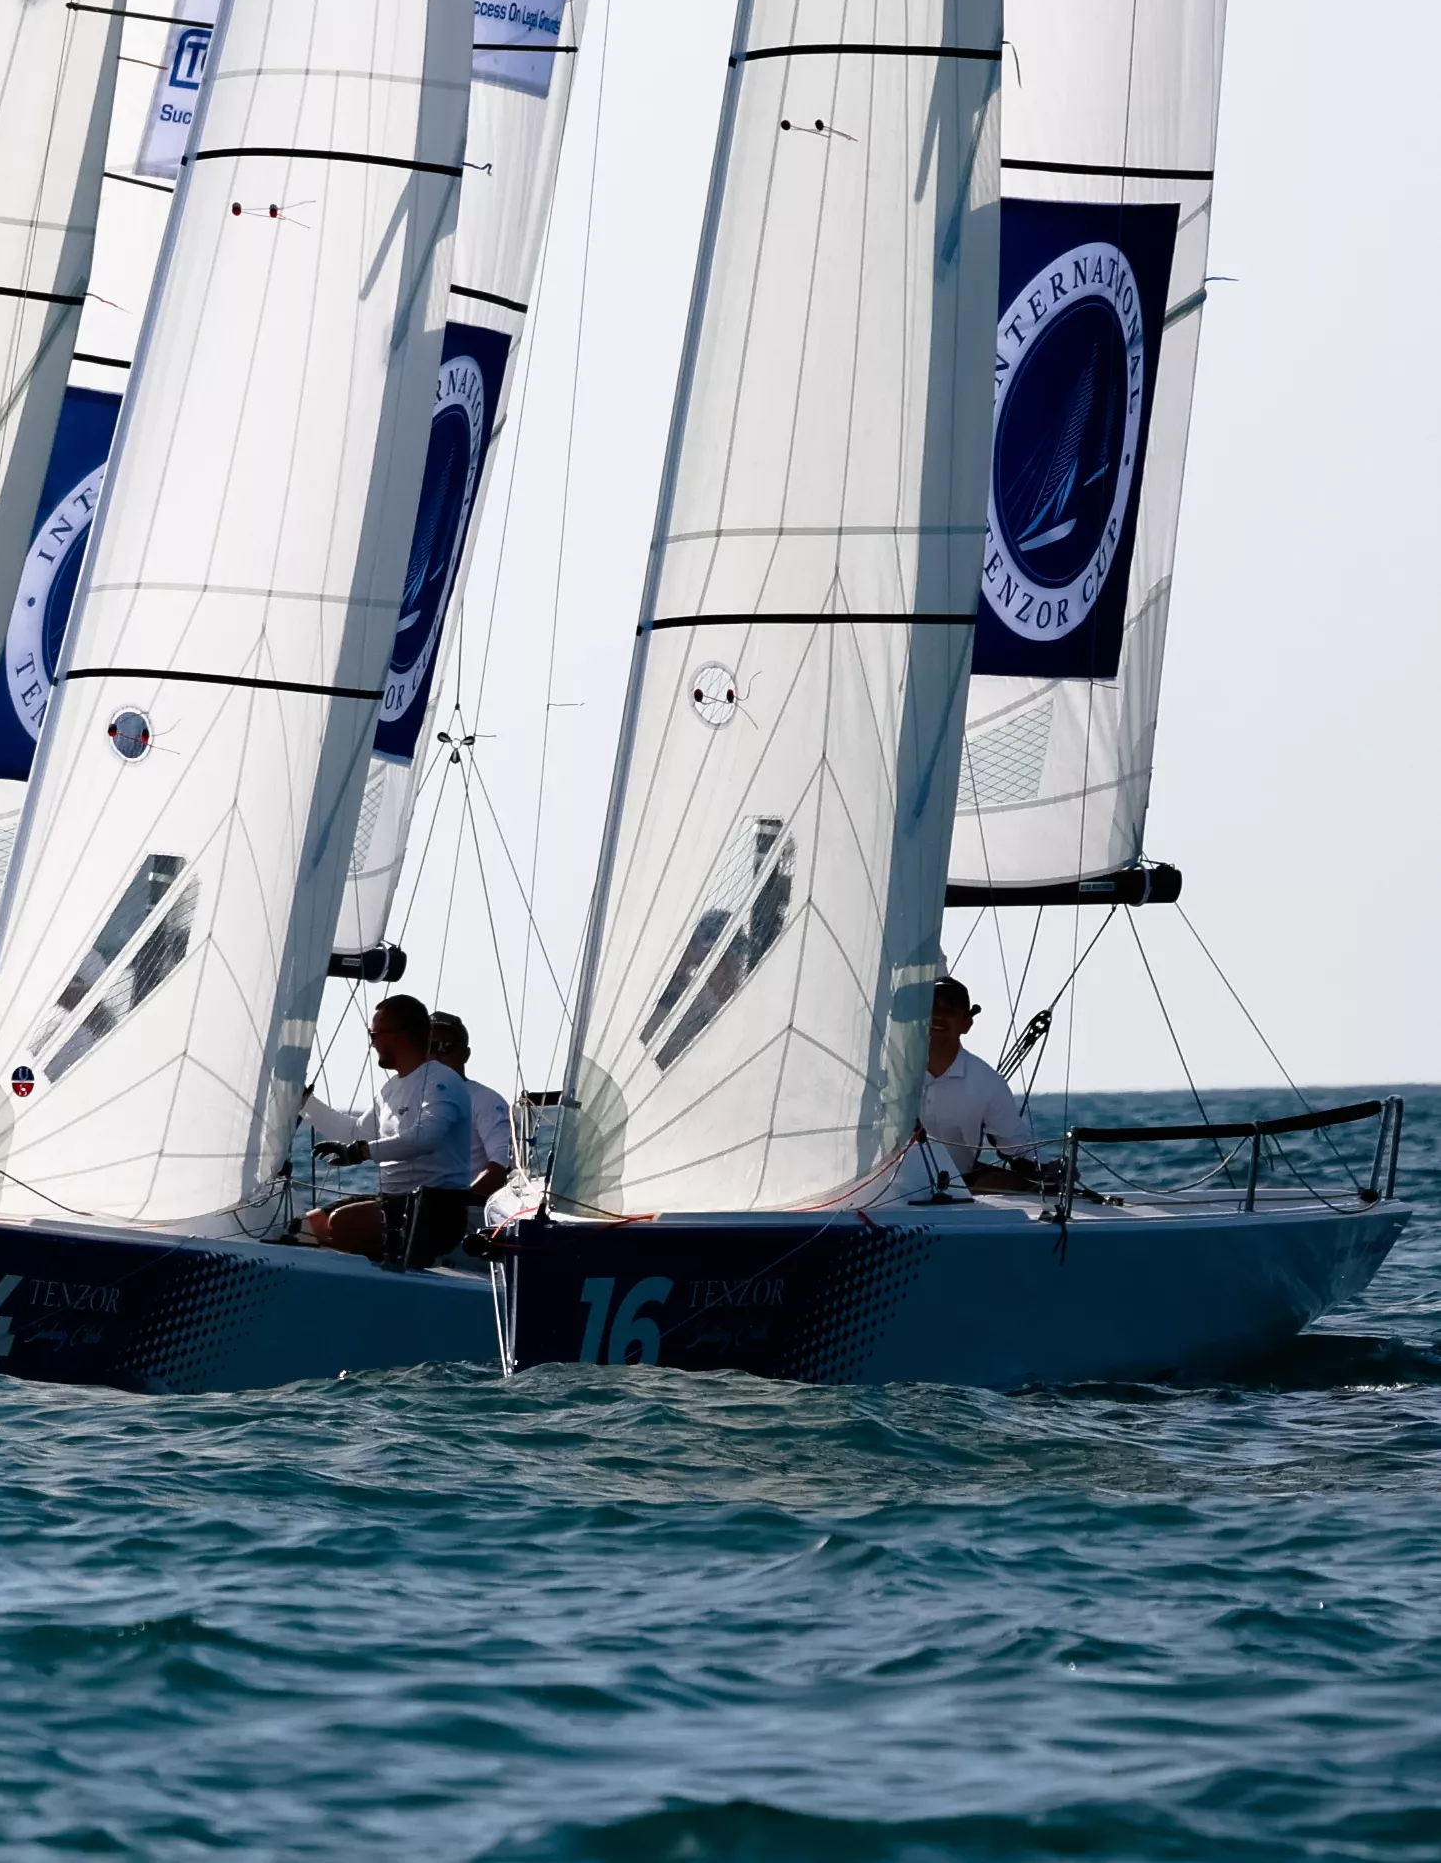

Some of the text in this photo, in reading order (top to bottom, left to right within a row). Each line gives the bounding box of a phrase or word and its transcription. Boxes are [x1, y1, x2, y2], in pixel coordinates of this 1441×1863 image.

[474, 0, 507, 19] ccess
[509, 3, 521, 22] On
[994, 252, 1140, 414] NTERNATIONAL
[1082, 517, 1119, 604] CUP
[30, 1279, 121, 1314] TENZOR
[579, 1276, 786, 1365] 16 TENZOR
